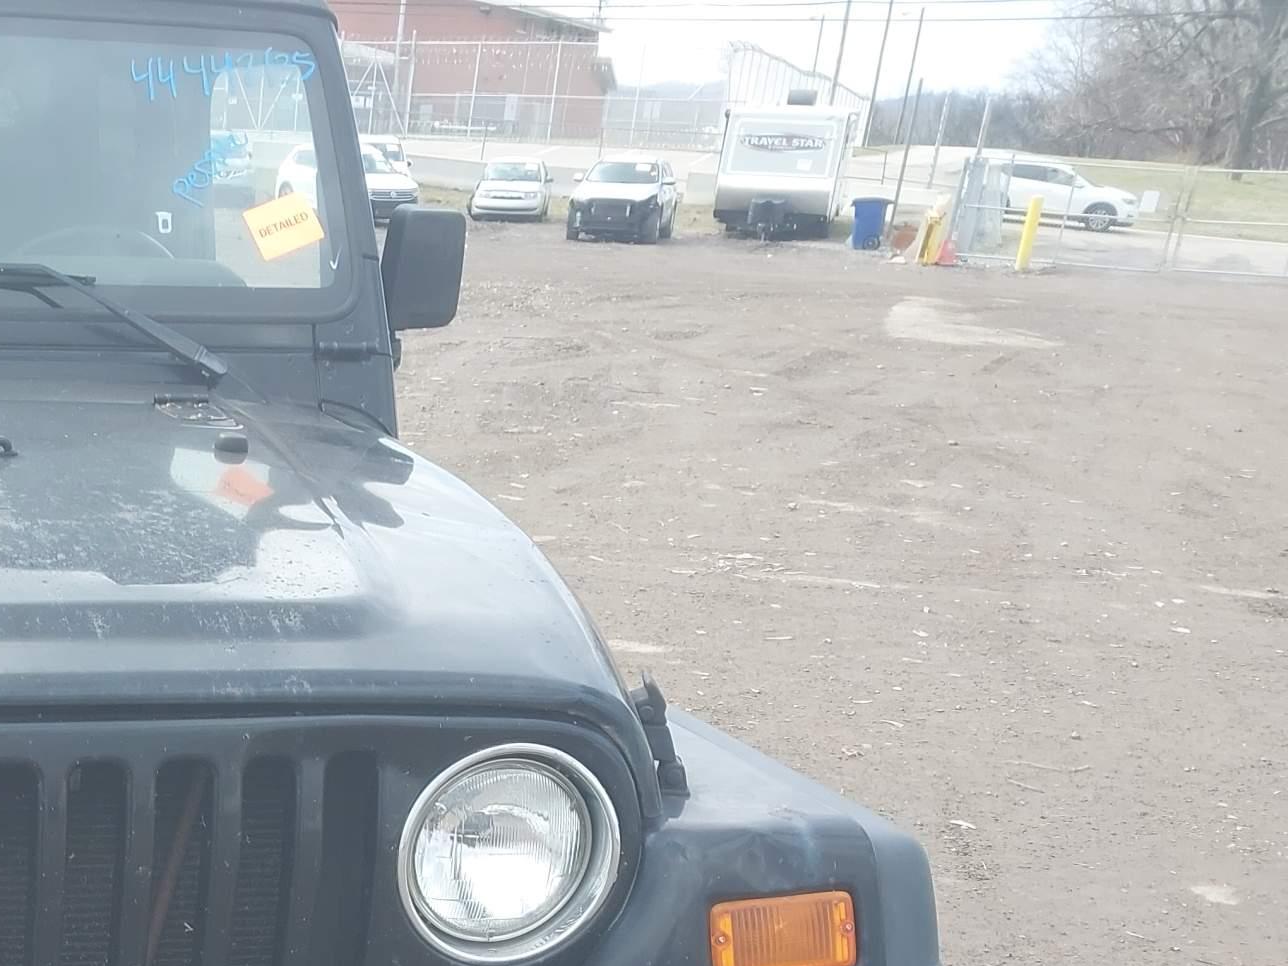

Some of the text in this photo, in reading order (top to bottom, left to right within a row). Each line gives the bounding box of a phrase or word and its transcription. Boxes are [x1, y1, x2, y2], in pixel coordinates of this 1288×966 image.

[744, 136, 823, 147] TRAVEL STAR
[258, 211, 309, 239] DETAILED
